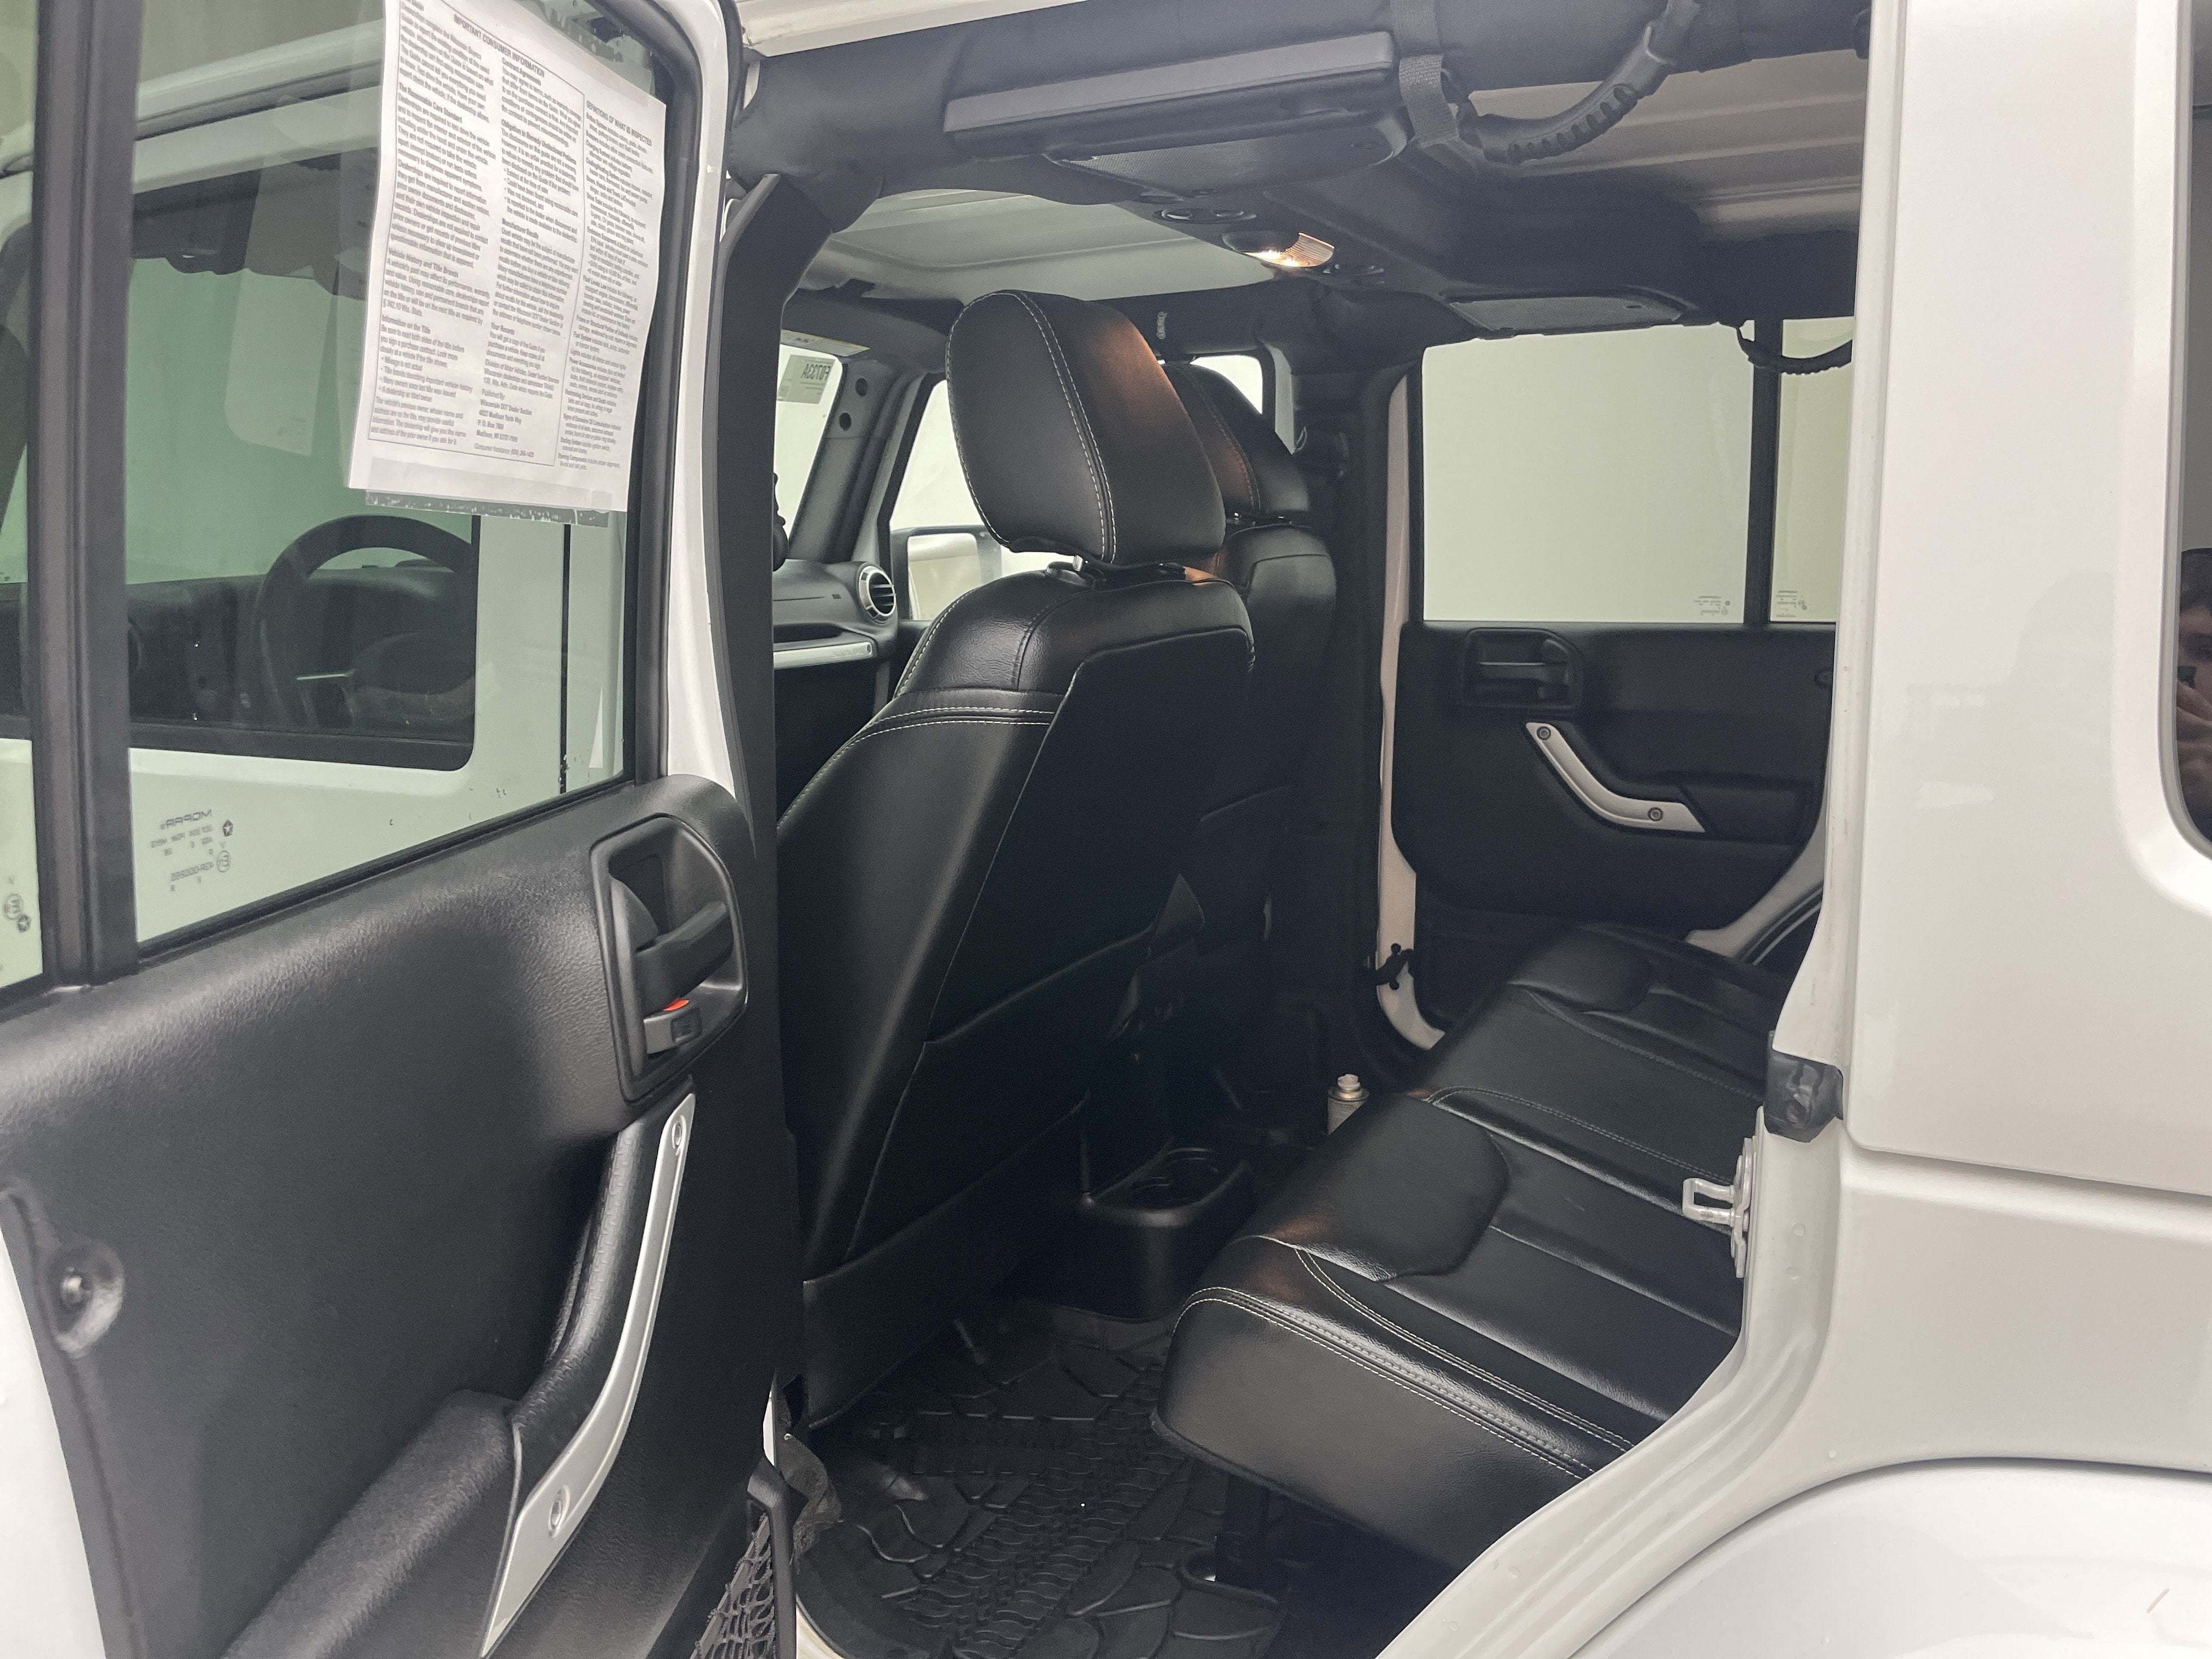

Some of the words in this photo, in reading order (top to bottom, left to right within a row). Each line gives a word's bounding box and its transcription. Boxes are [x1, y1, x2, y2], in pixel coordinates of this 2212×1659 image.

[454, 14, 482, 40] IMPORTANT
[483, 33, 511, 58] CONSUMER
[512, 52, 545, 78] INFORMATION
[389, 247, 405, 260] Vehicle
[406, 253, 423, 267] History
[424, 260, 433, 269] and
[434, 263, 443, 273] Title
[443, 266, 459, 278] Brands
